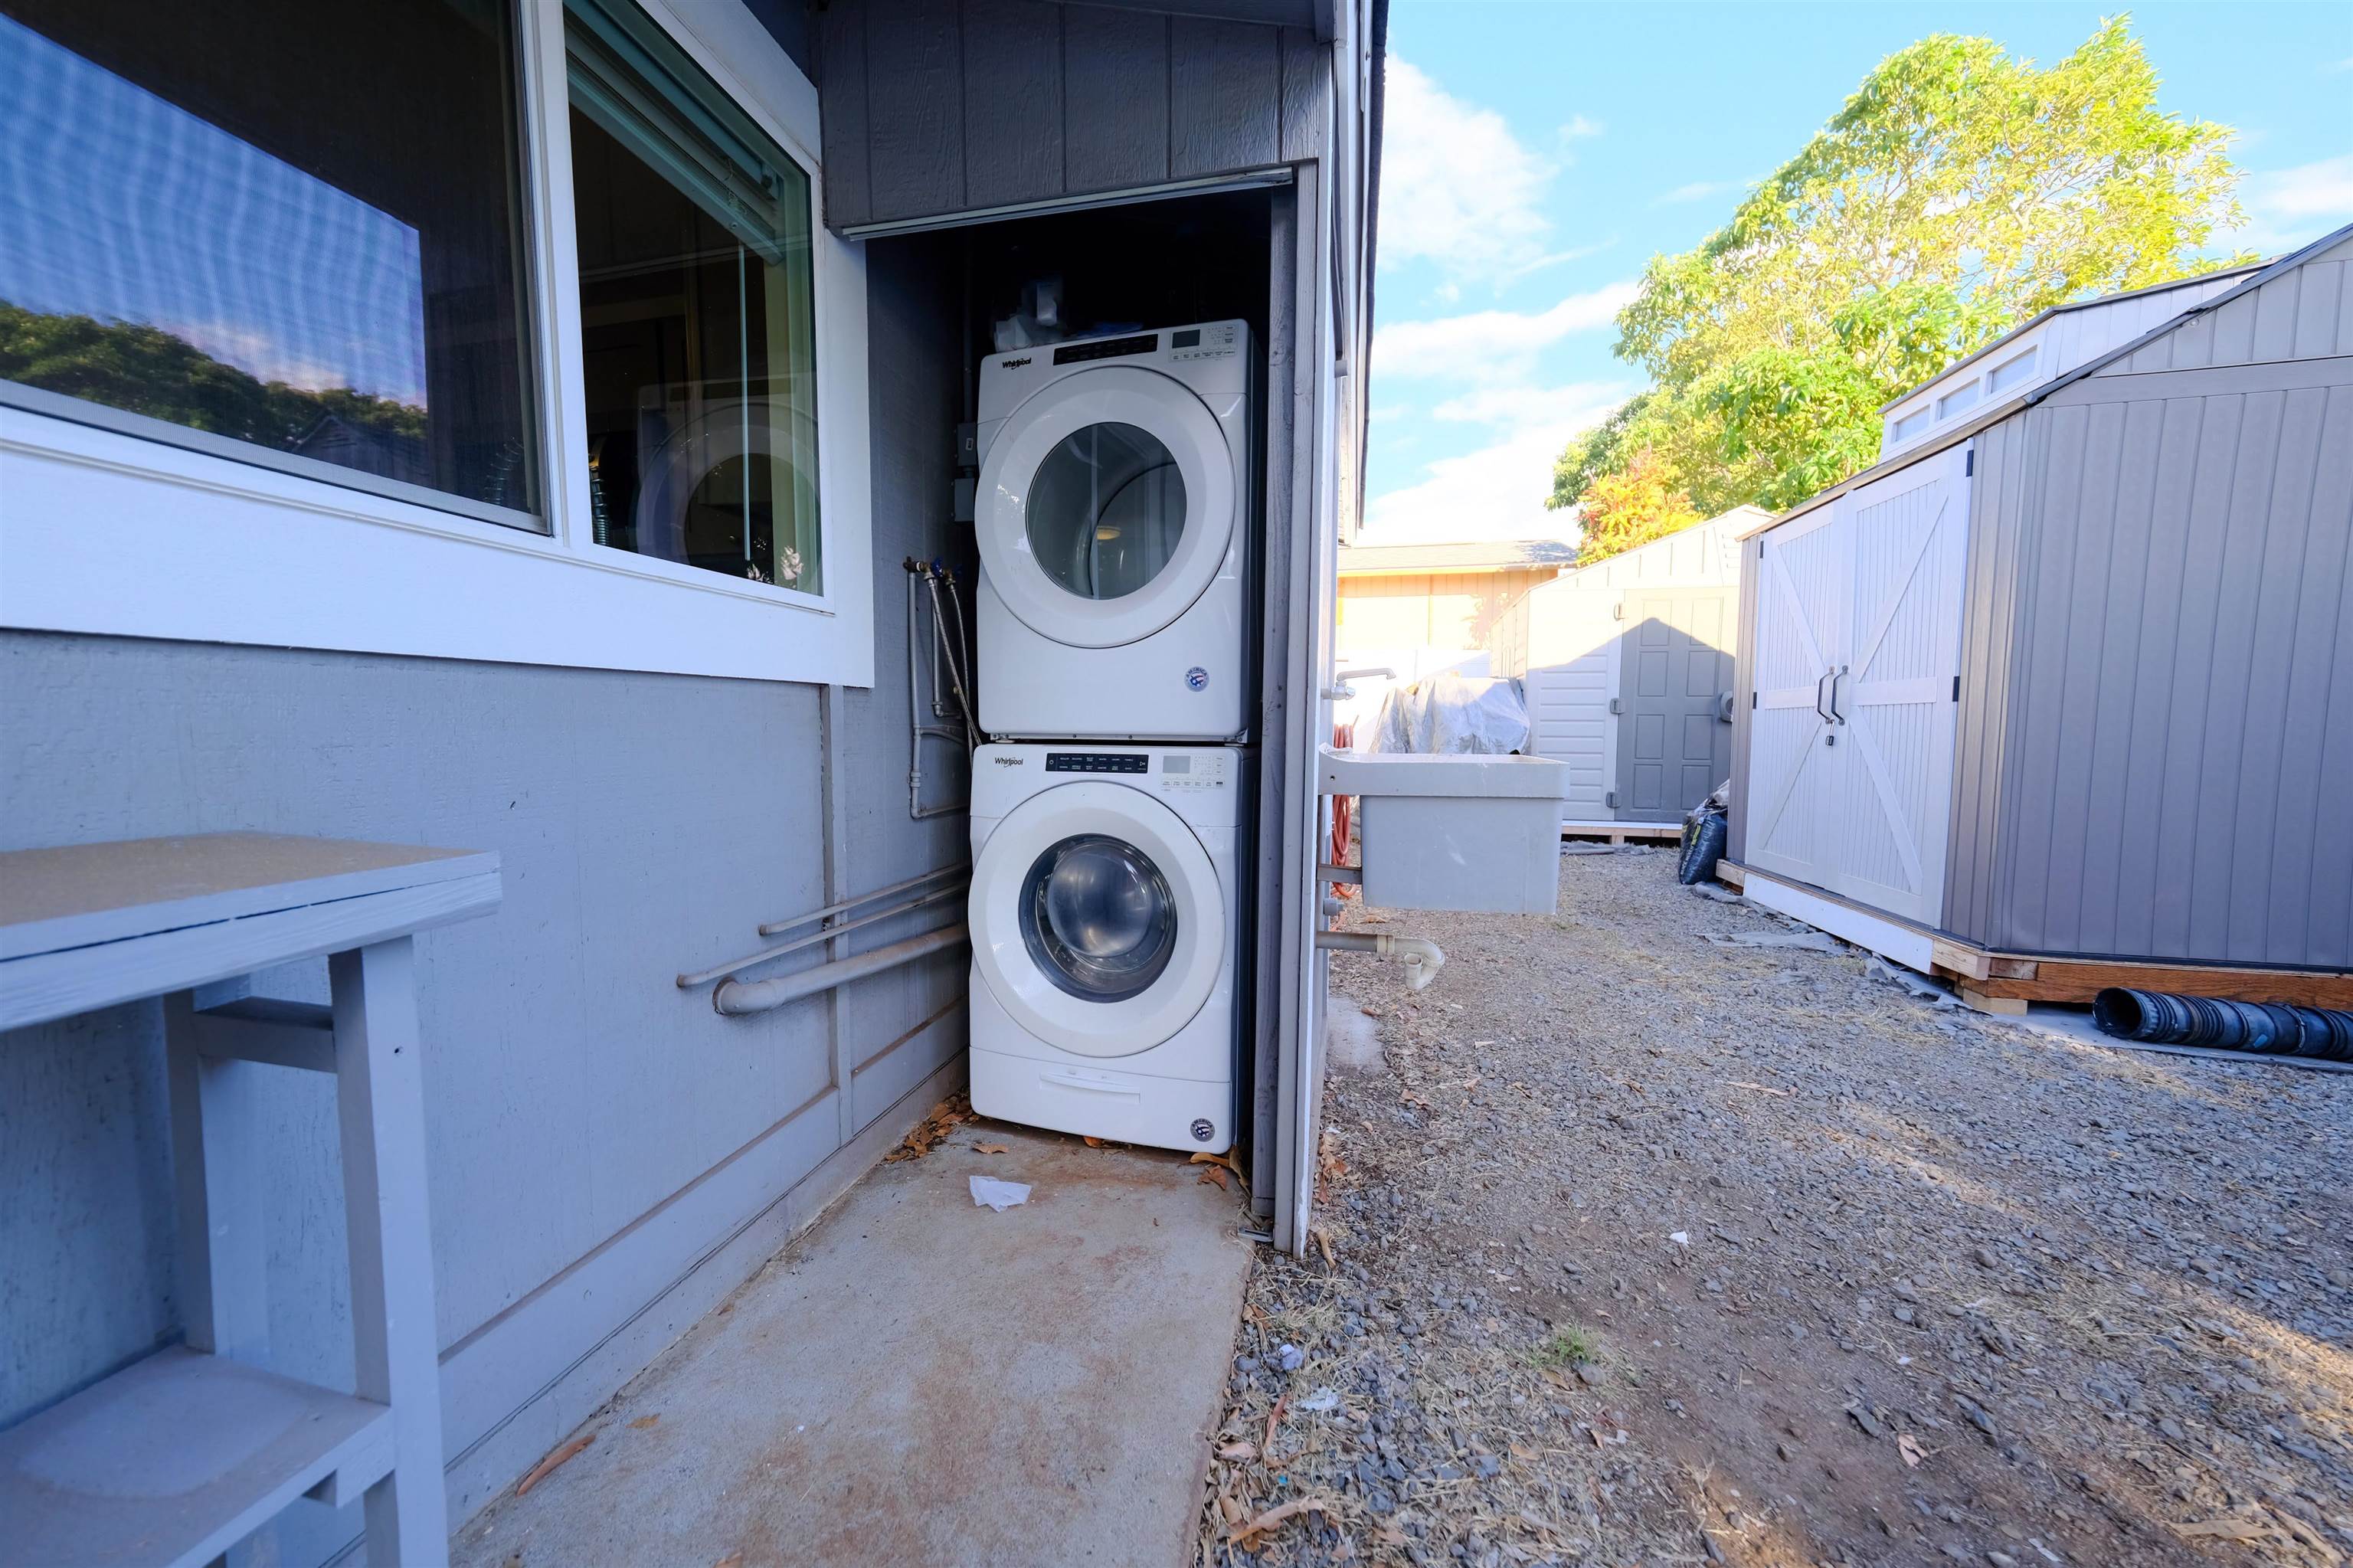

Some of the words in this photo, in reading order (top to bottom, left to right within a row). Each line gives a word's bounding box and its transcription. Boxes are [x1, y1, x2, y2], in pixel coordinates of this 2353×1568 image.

[1002, 358, 1032, 370] Whirlpool
[994, 757, 1023, 768] Whirlpool
[1191, 1118, 1213, 1128] AMERICA
